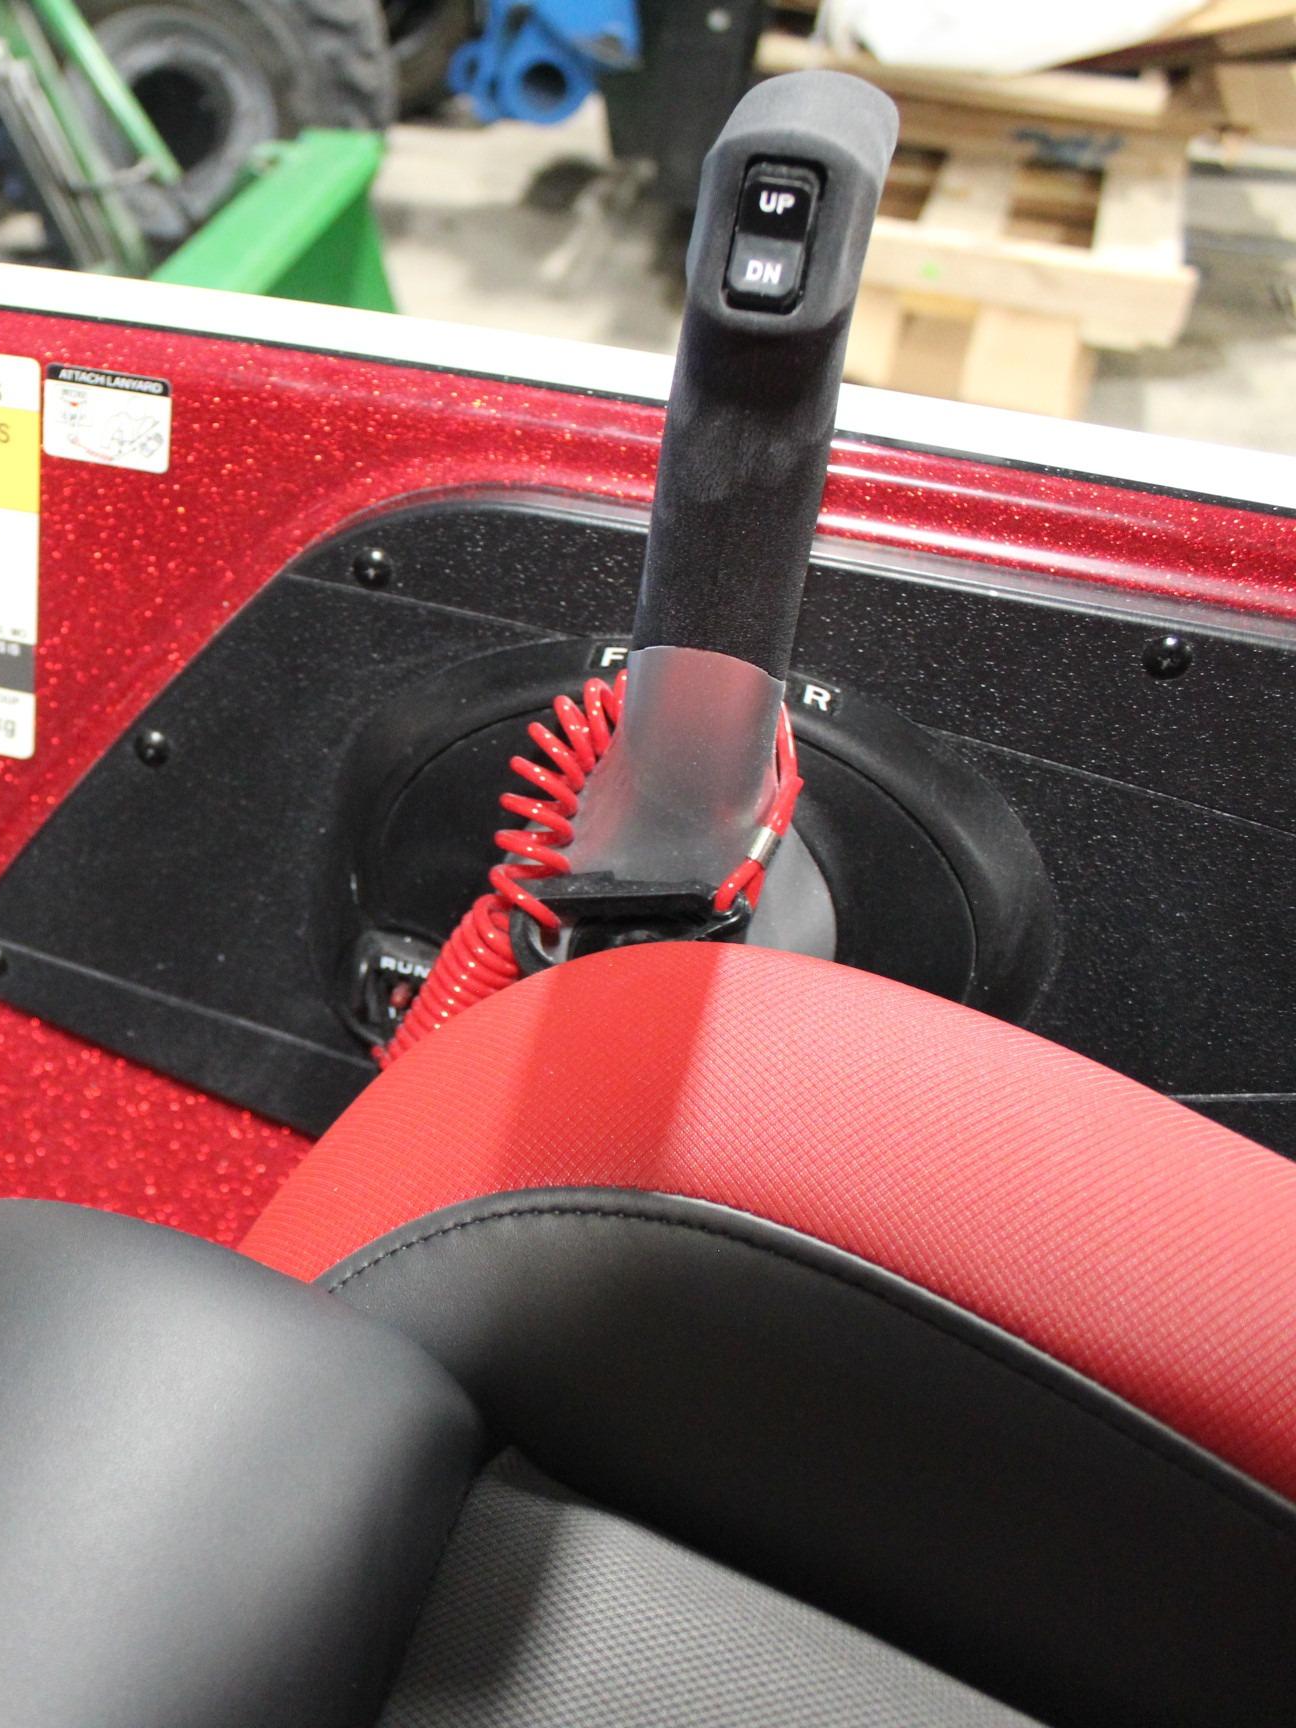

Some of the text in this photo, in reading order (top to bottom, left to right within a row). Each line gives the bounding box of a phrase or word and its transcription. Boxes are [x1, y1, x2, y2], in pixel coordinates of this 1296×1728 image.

[759, 191, 796, 215] UP
[744, 260, 783, 285] DN
[58, 369, 106, 385] ATTACH
[107, 376, 163, 394] LANYARD
[600, 646, 629, 668] F
[803, 684, 833, 711] R
[379, 956, 432, 979] RUN
